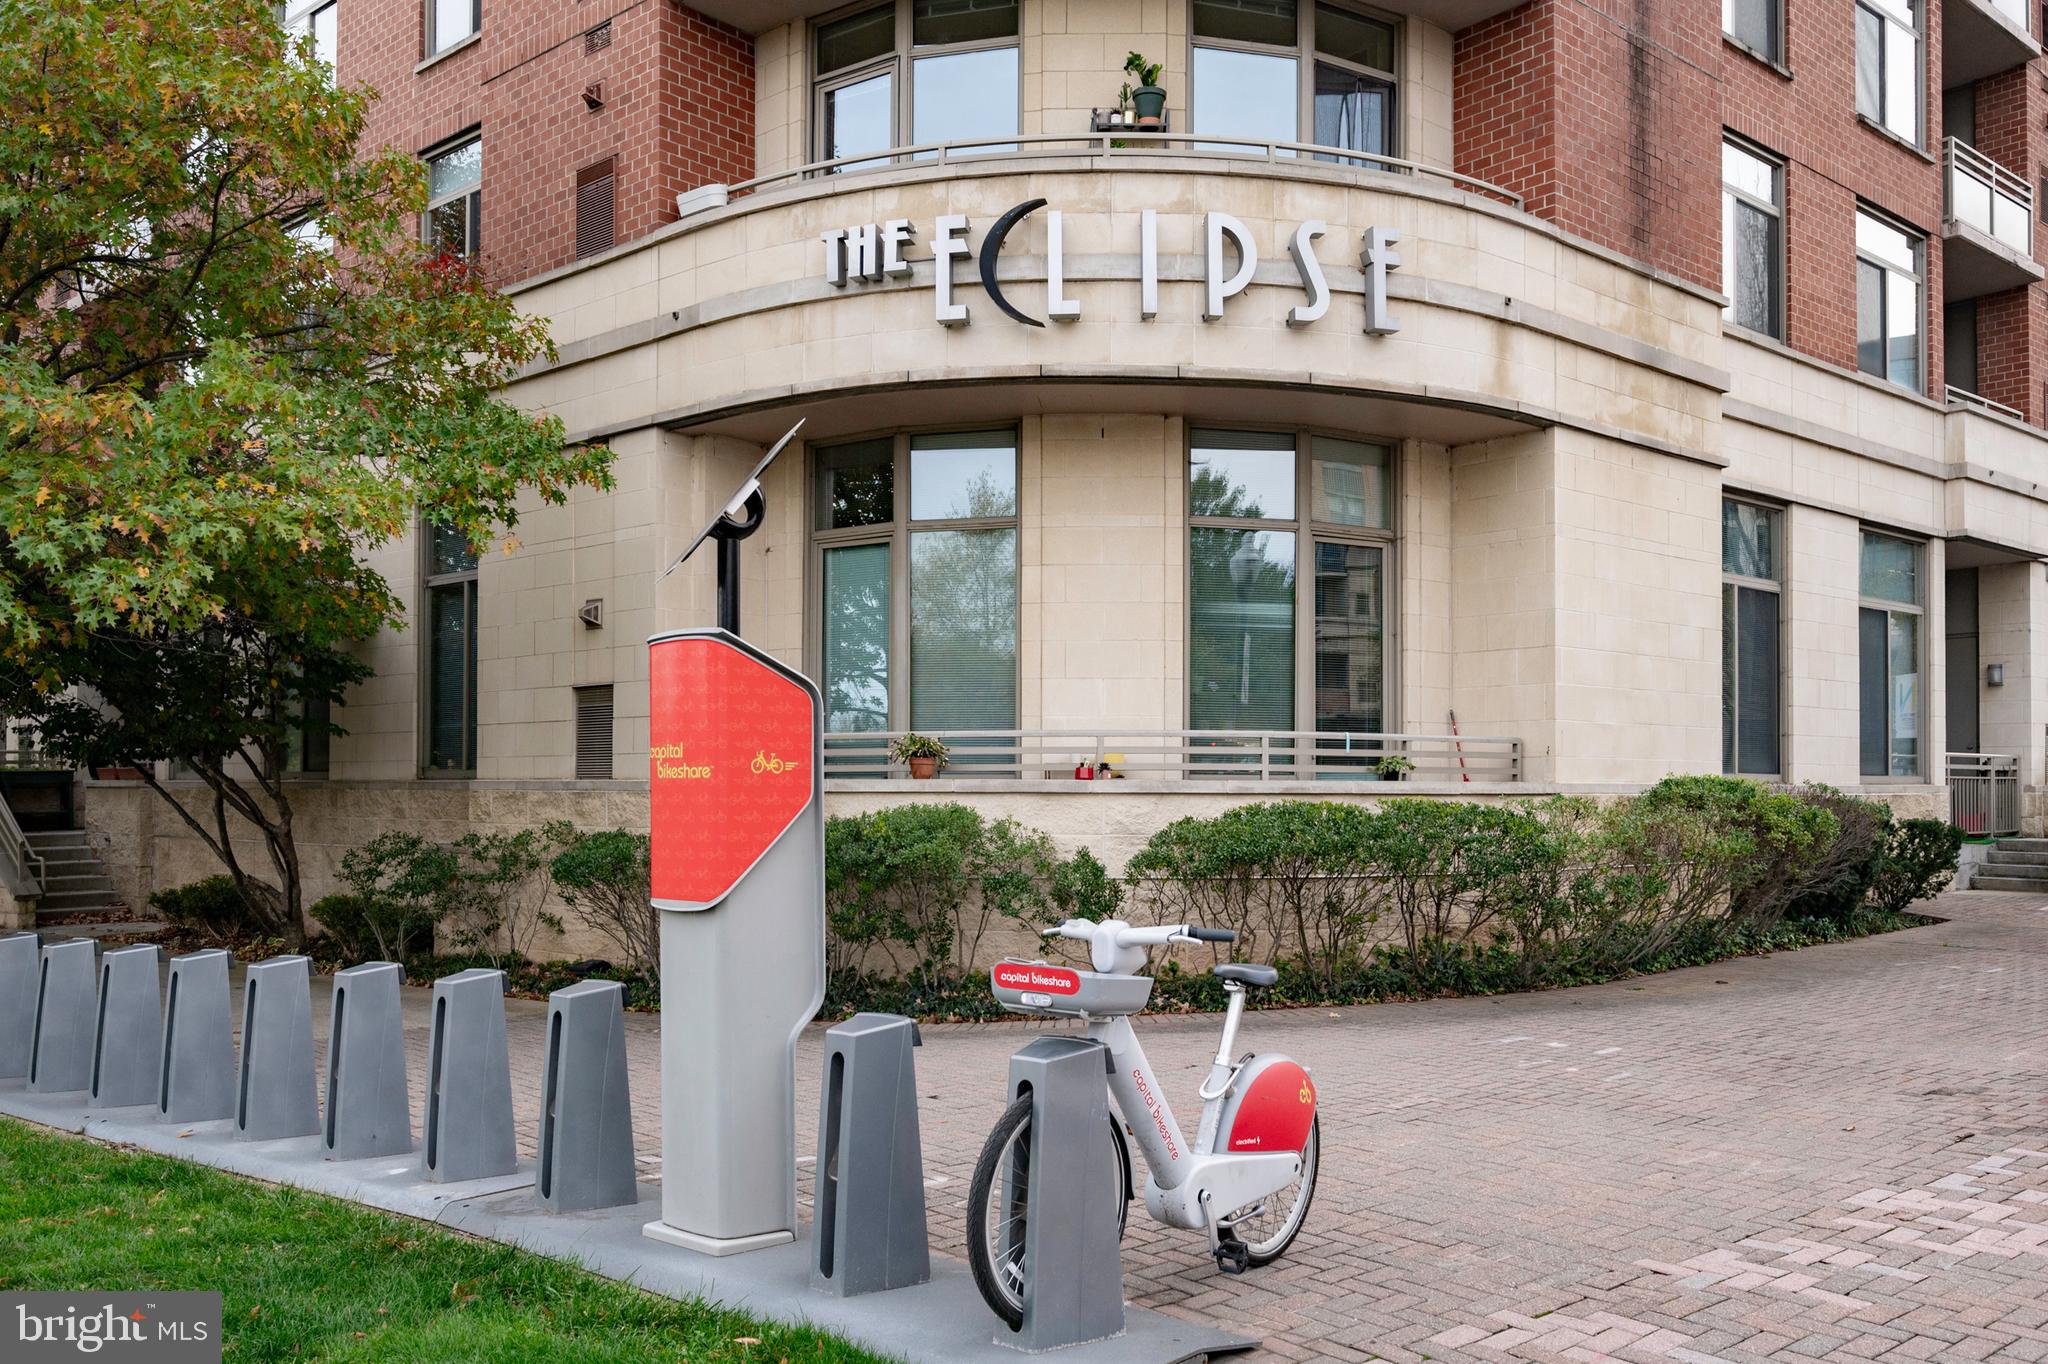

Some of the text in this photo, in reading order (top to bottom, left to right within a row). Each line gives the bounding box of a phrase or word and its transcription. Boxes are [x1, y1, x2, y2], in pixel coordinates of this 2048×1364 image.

[820, 197, 1401, 336] THE ECLIPSE
[650, 741, 683, 763] capital
[657, 760, 712, 778] bikeshare
[1000, 971, 1072, 988] capital bikeshare
[1132, 1069, 1179, 1160] capital bikeshare
